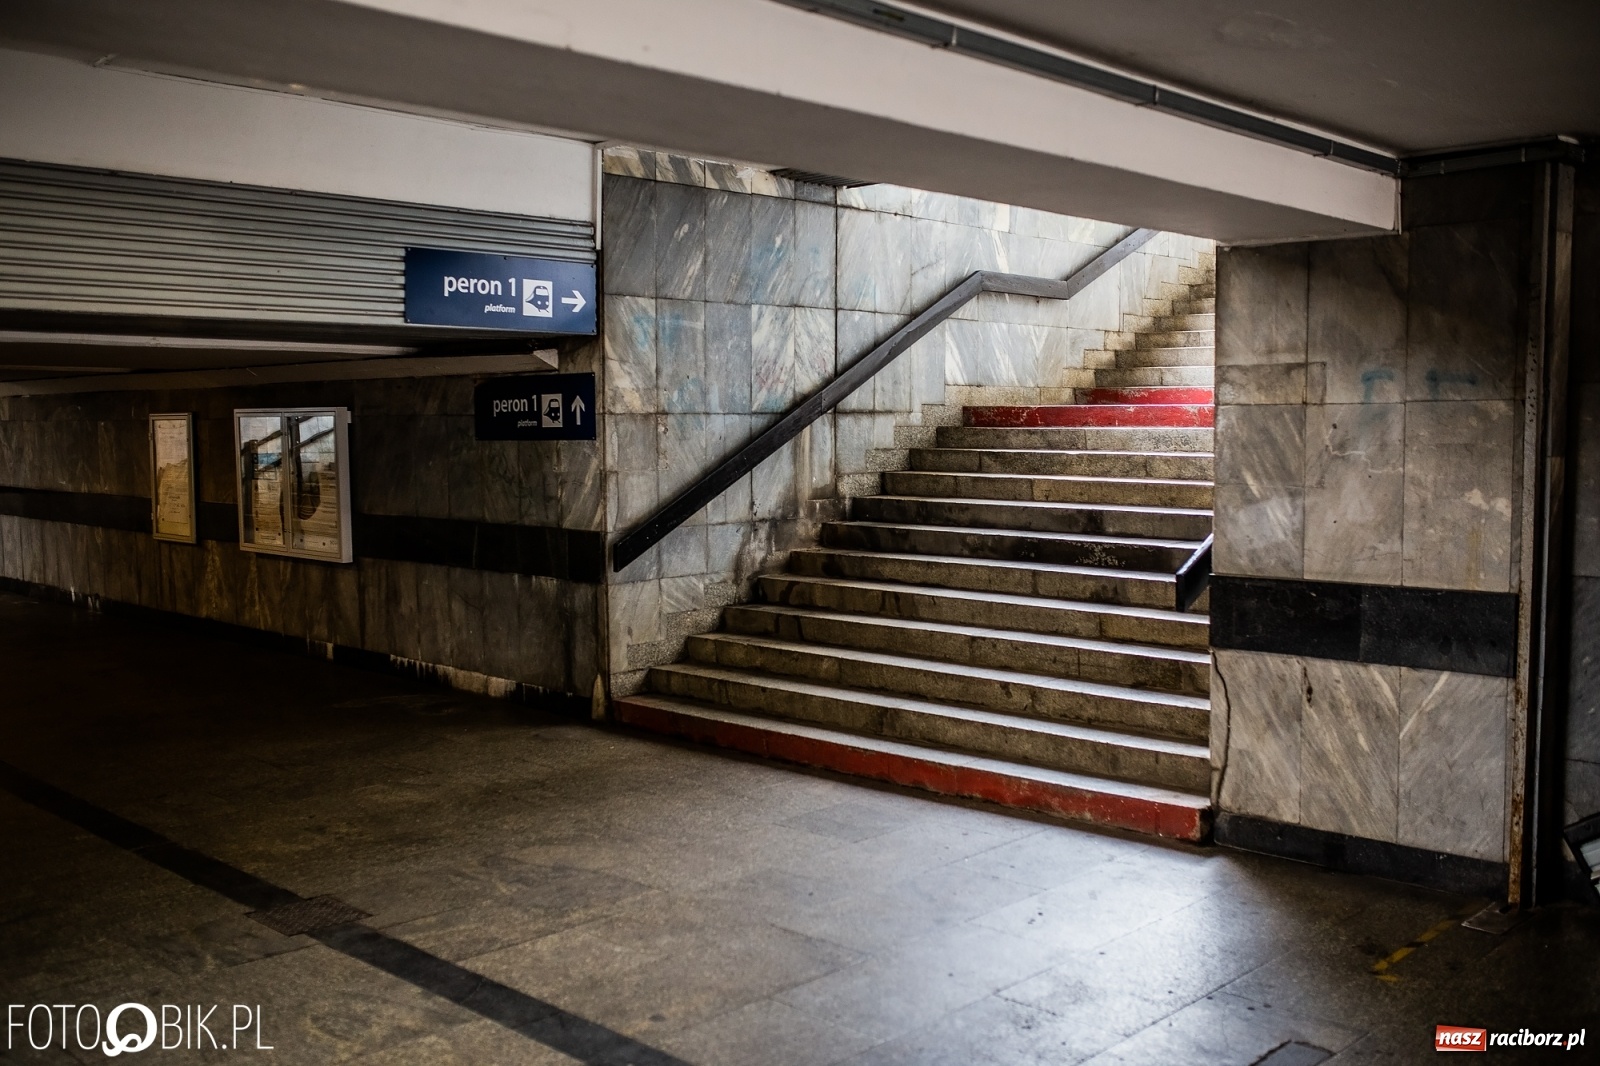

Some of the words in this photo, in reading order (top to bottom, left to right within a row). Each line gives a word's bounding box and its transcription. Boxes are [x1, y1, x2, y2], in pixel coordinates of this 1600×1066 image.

[444, 275, 502, 297] peron
[508, 277, 516, 297] 1
[484, 303, 516, 314] platform
[493, 398, 528, 417] peron
[531, 394, 538, 412] 1
[517, 419, 538, 429] platform
